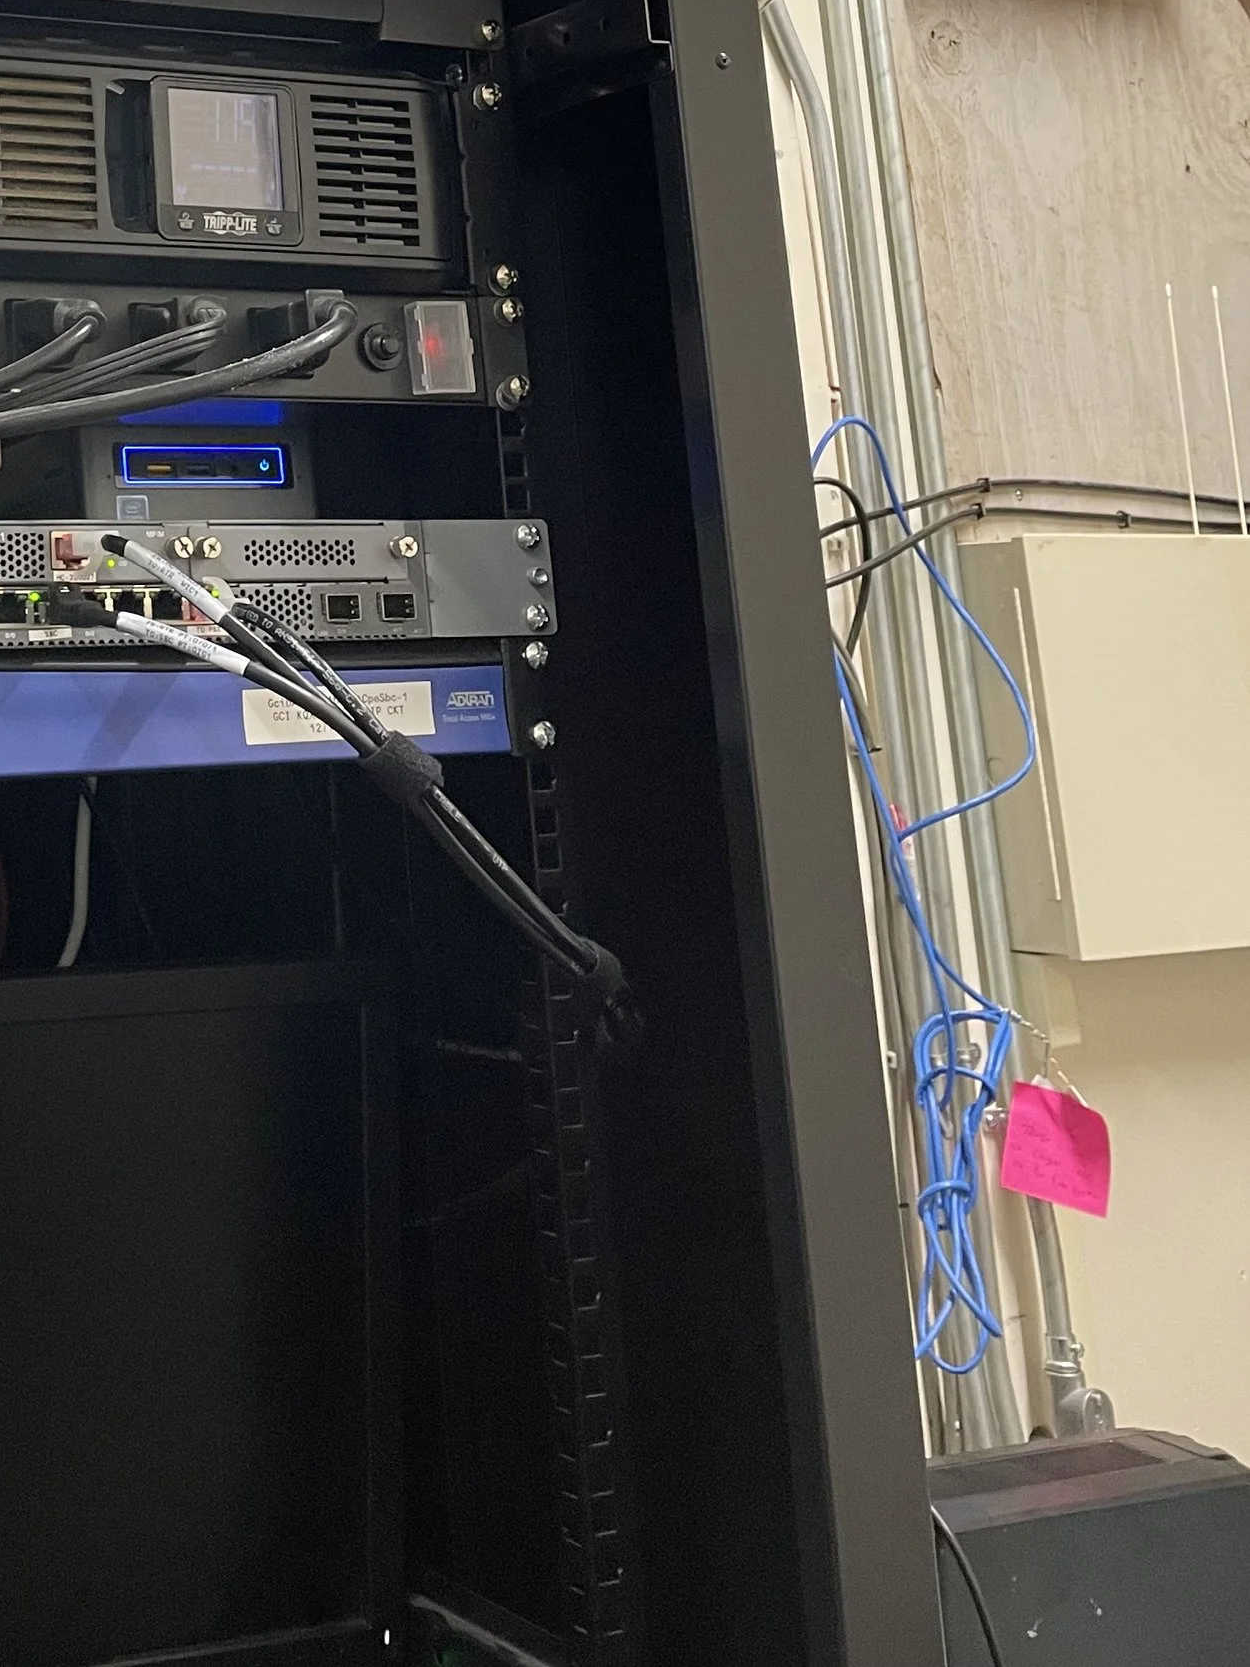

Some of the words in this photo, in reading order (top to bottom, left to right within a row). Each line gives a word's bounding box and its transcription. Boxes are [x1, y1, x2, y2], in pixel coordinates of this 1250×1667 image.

[447, 692, 495, 707] ADTRAN
[273, 710, 290, 720] GCI
[387, 705, 404, 715] CKT
